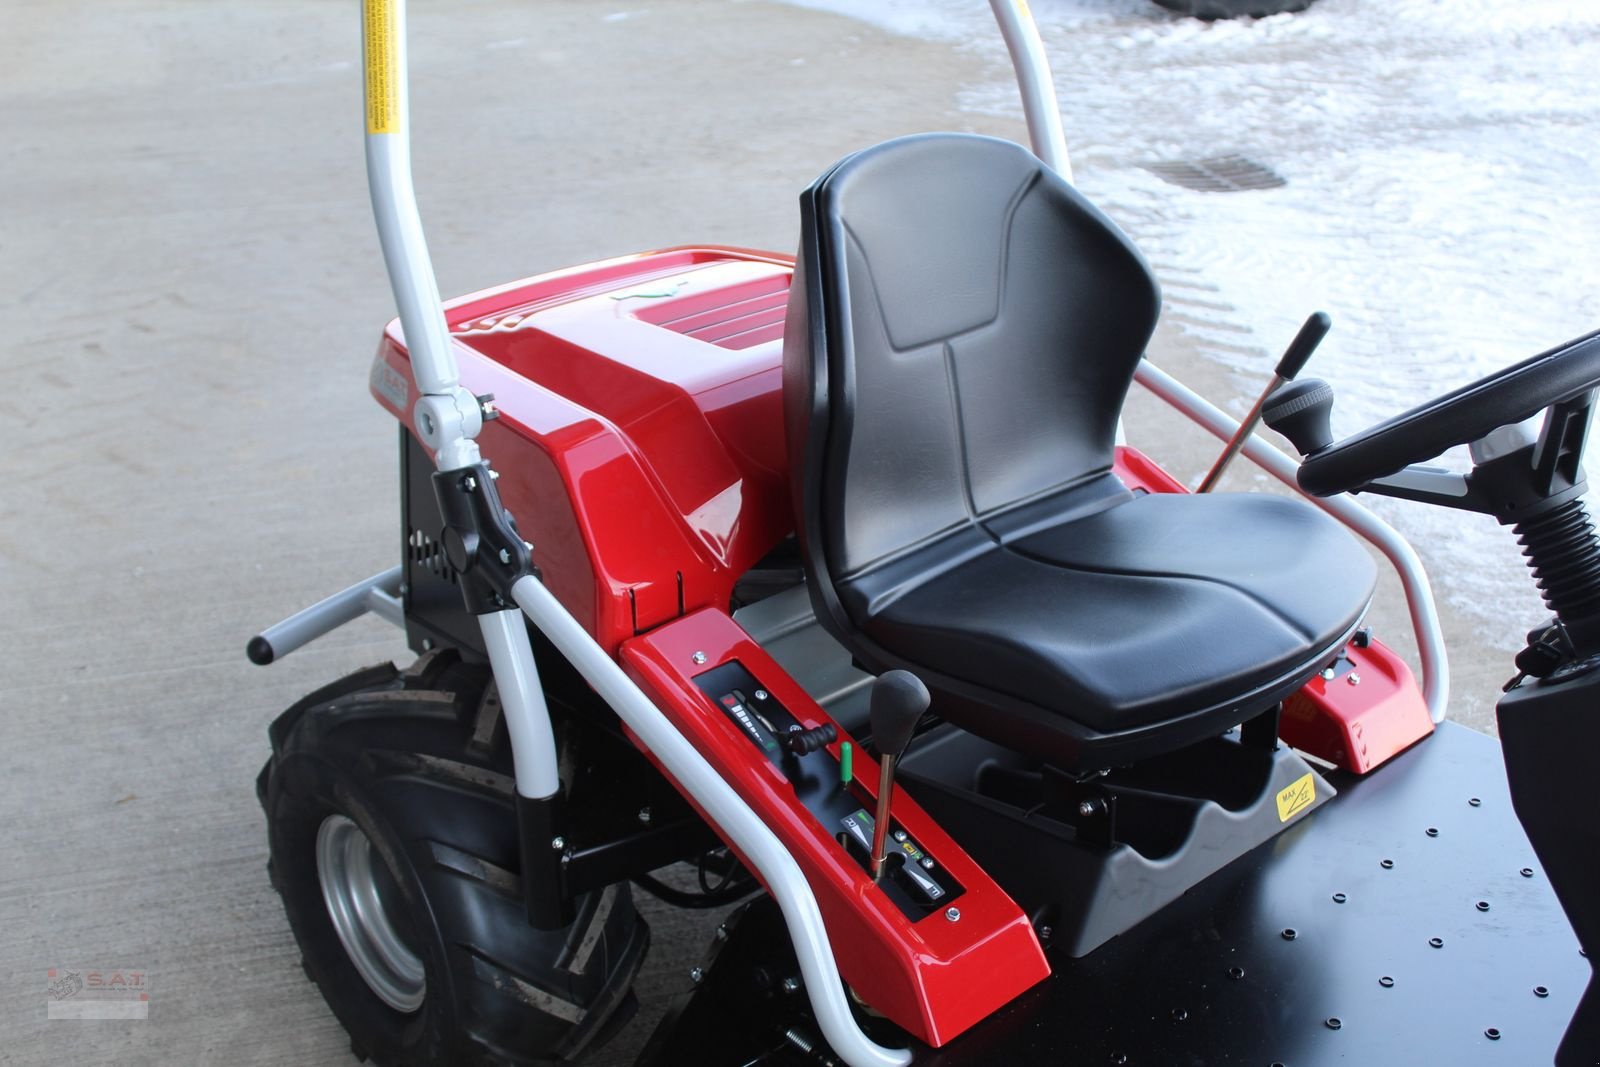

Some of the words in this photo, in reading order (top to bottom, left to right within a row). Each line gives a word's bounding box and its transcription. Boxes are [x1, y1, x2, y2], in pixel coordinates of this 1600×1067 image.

[1282, 788, 1296, 802] MAX
[845, 818, 856, 827] R
[931, 886, 941, 896] F
